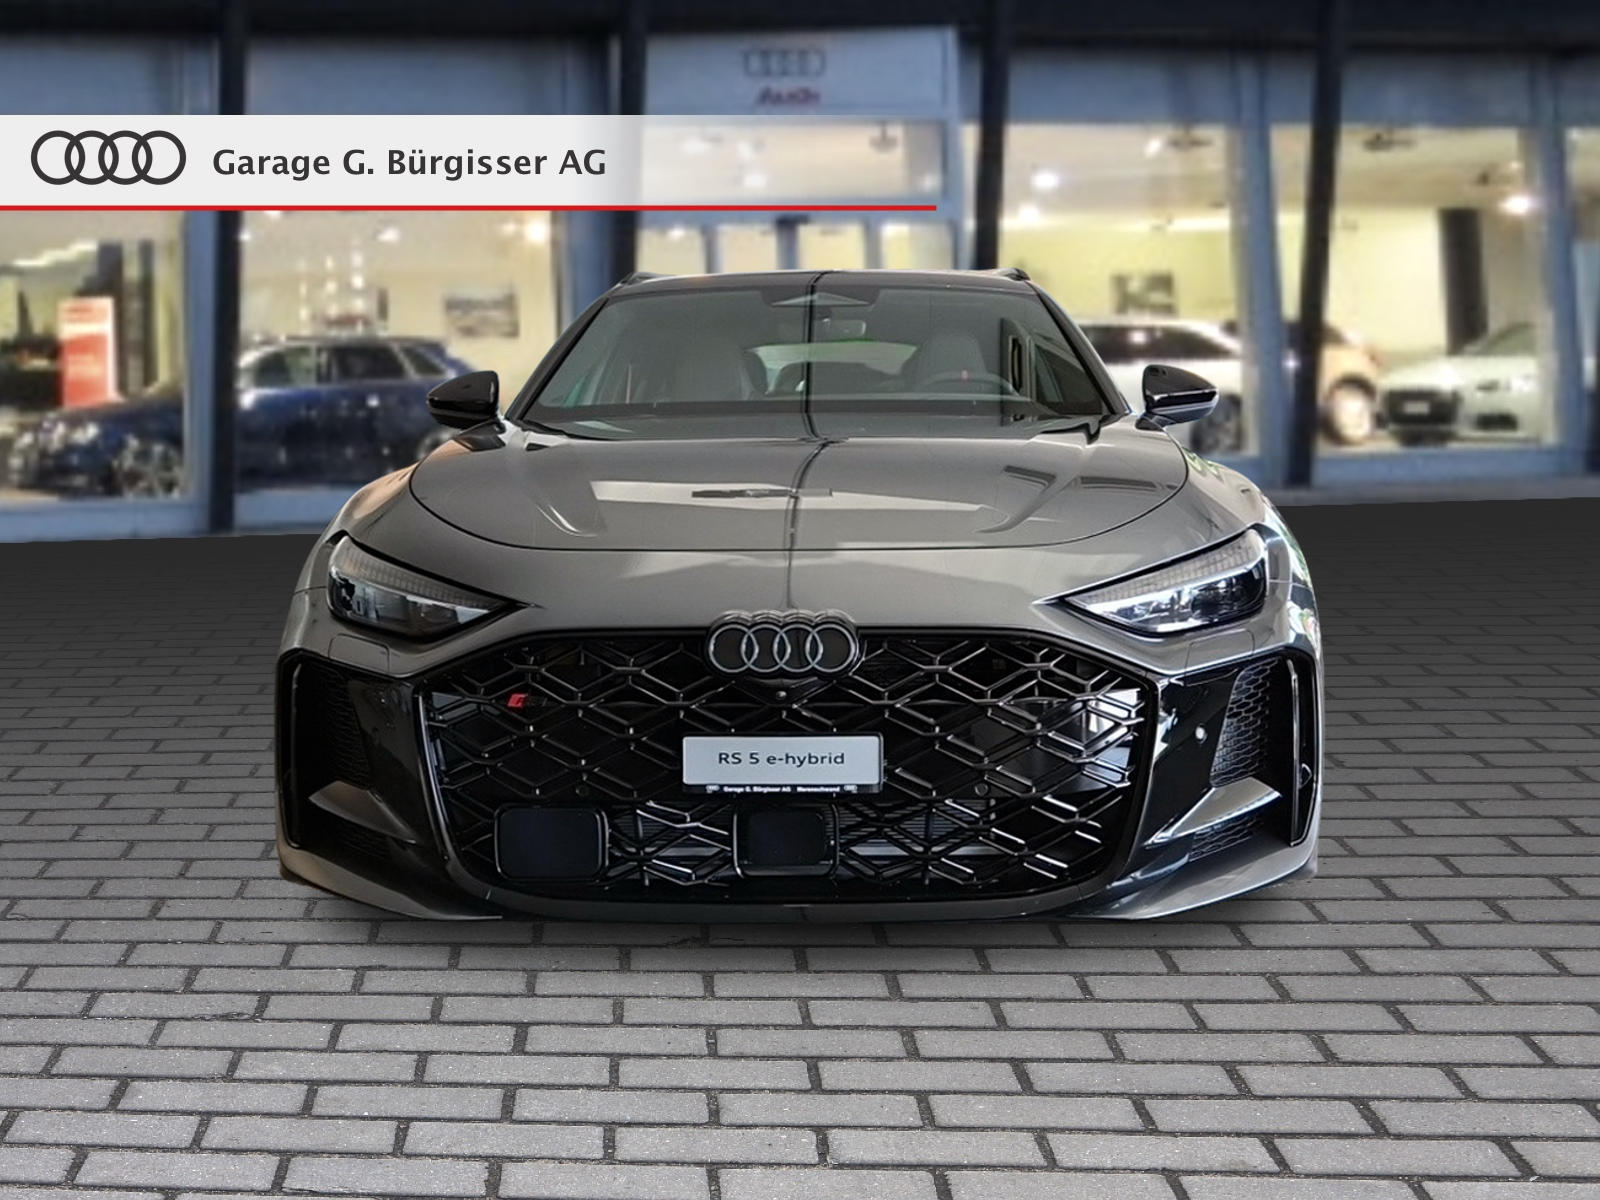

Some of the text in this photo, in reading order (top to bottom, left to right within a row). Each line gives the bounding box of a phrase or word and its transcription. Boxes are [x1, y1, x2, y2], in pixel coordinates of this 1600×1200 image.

[718, 752, 845, 768] RS 5 e-hybrid
